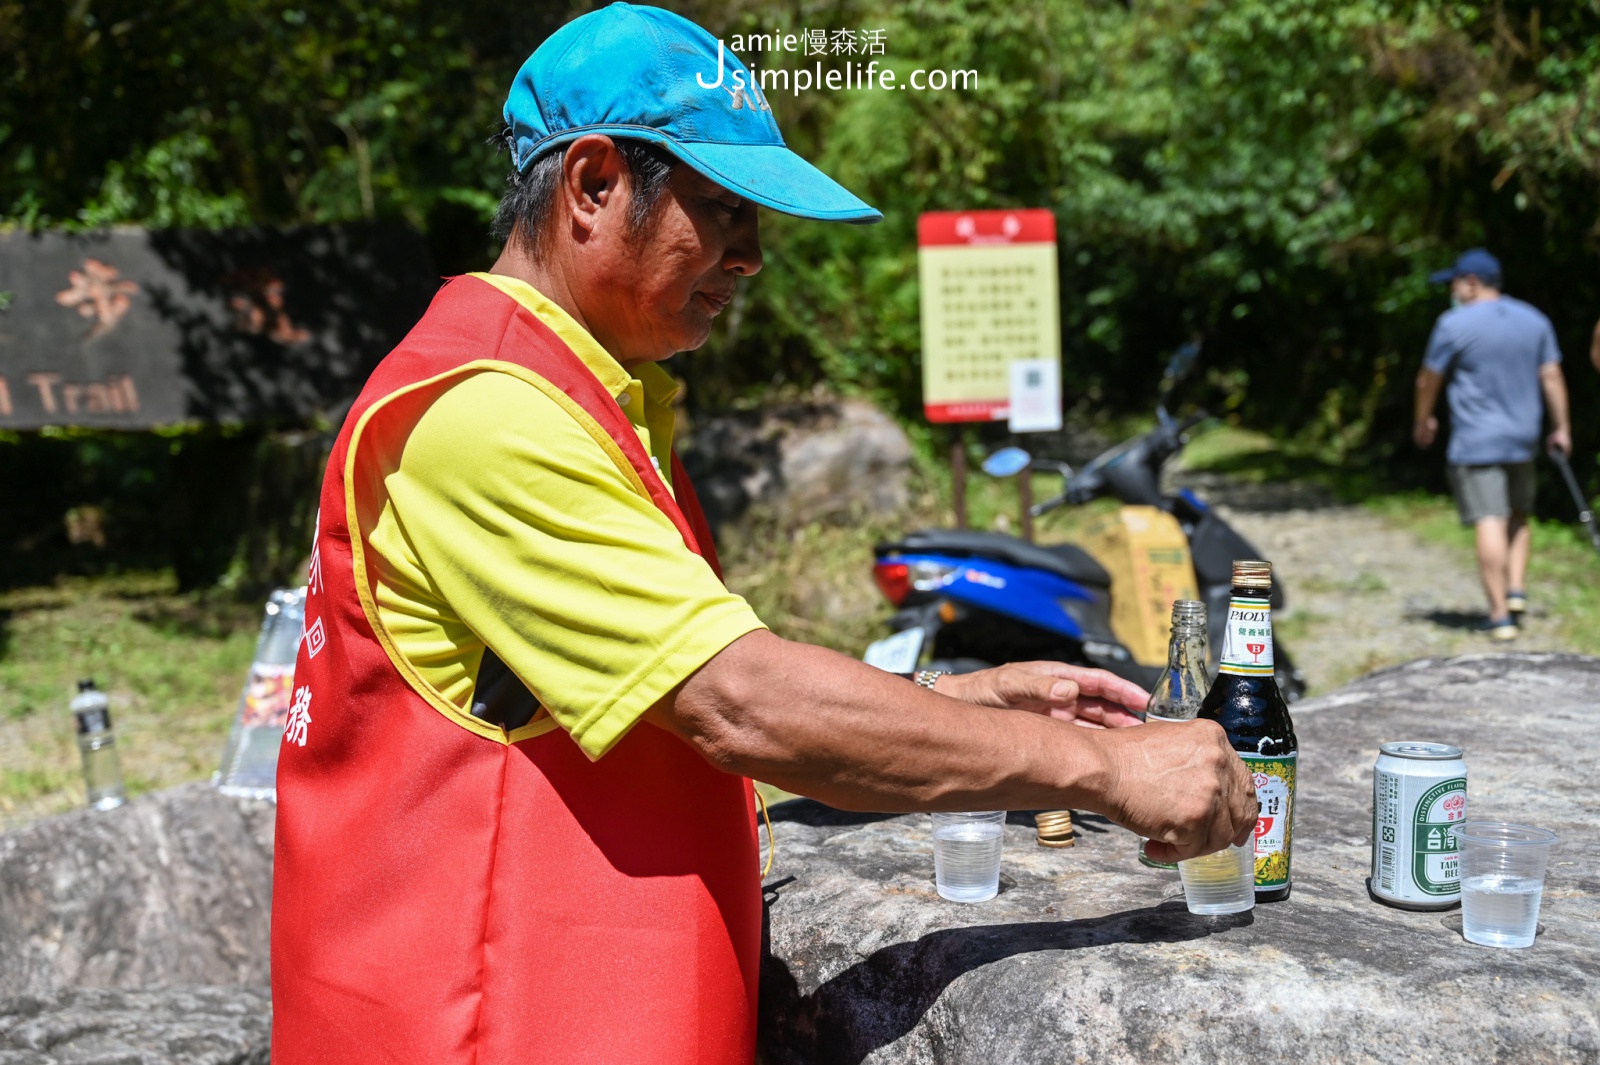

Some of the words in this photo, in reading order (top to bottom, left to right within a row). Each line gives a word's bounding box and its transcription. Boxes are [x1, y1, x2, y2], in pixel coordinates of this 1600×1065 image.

[27, 372, 140, 413] Trail
[1419, 786, 1446, 822] DISTINCTIVE
[1440, 859, 1459, 870] TAIW
[1444, 868, 1459, 879] BEE
